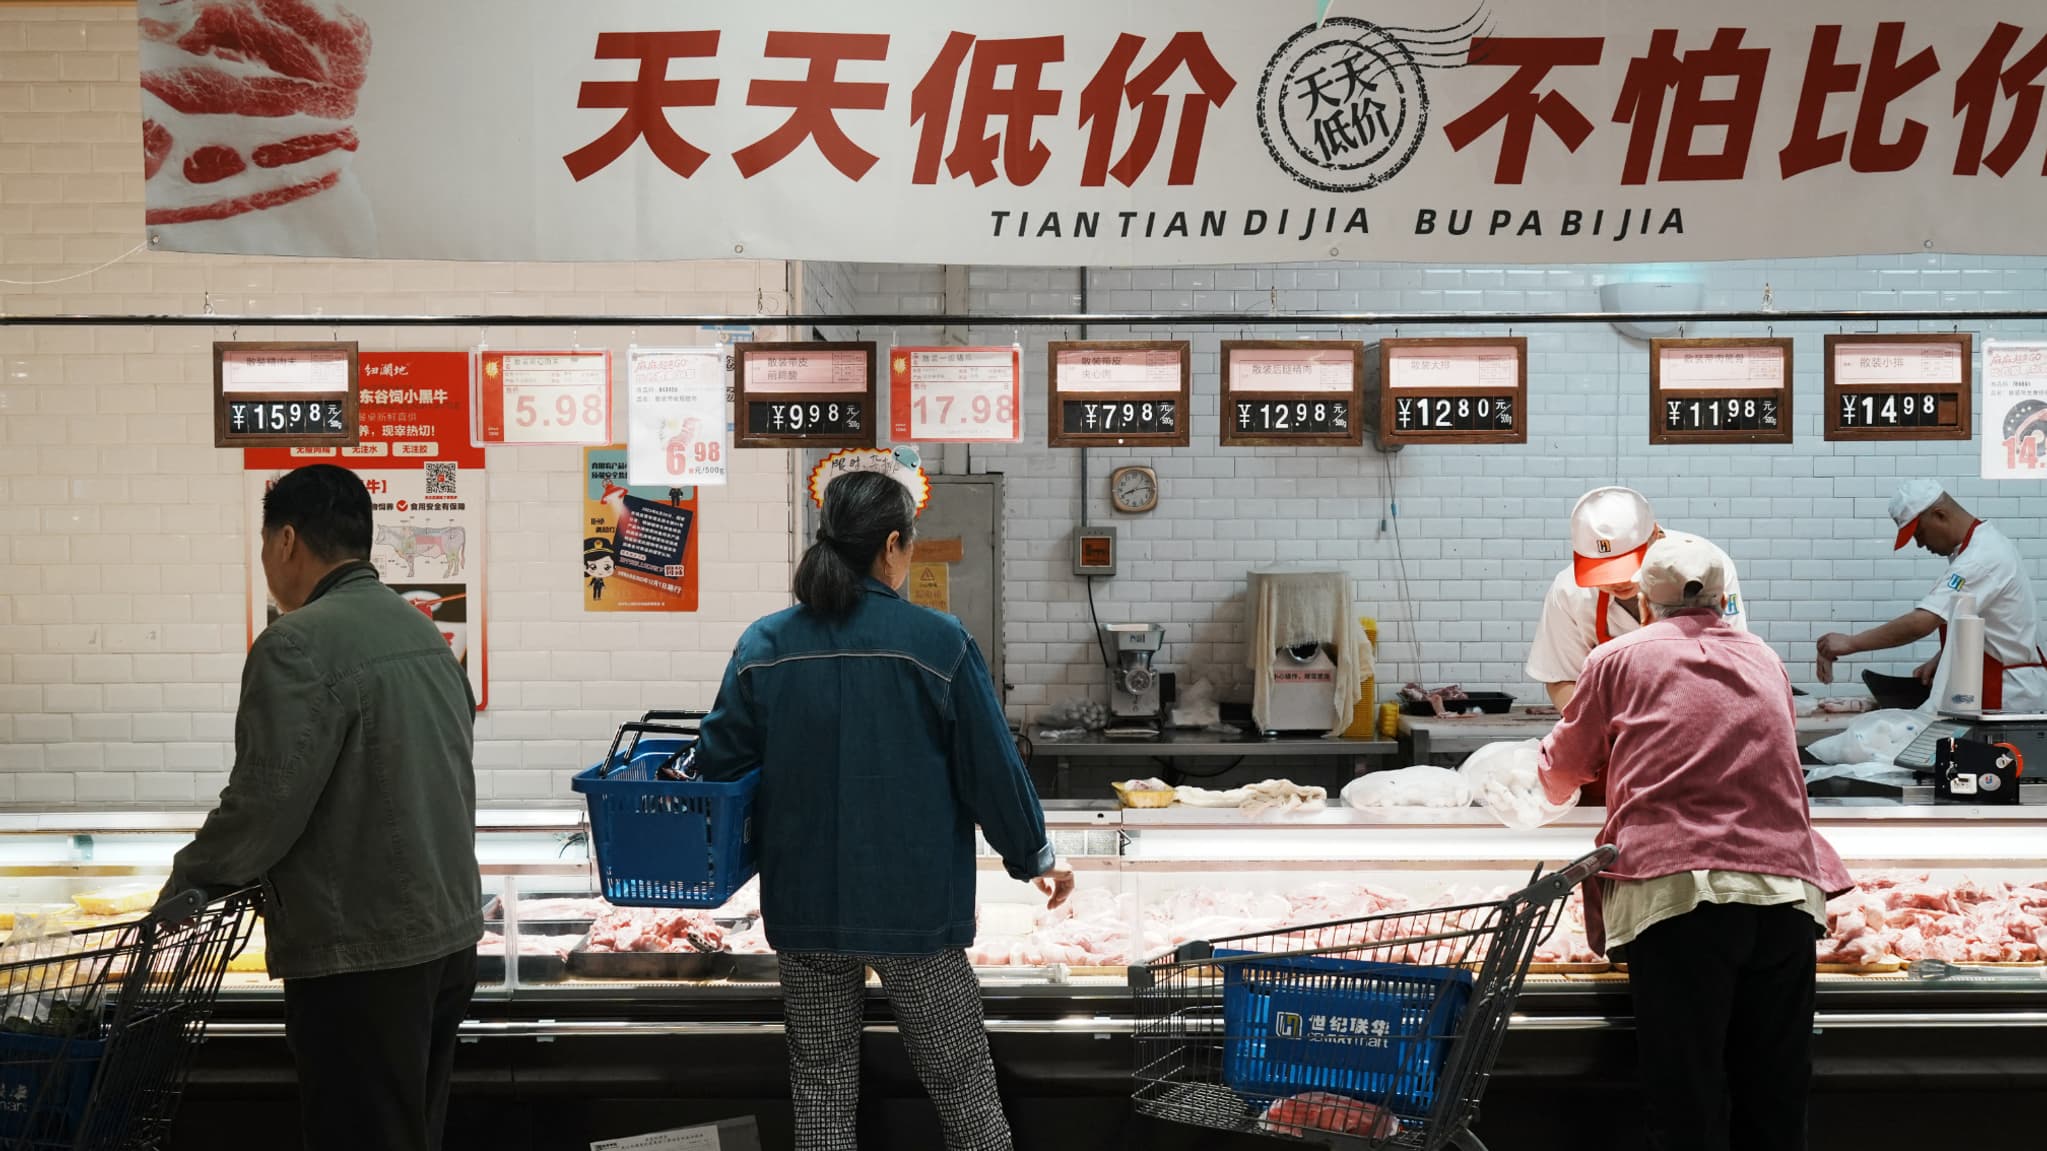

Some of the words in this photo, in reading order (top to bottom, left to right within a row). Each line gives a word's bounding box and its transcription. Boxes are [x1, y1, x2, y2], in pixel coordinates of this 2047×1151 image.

[1294, 51, 1377, 121] 天天
[1443, 21, 2047, 185] 不怕比价
[562, 29, 1237, 187] 天天低价
[1314, 97, 1390, 161] 低价
[359, 388, 449, 405] 东谷饲小黑牛
[515, 394, 604, 428] 5.98
[913, 394, 1013, 425] 17.98
[411, 502, 465, 511] 食用安全有保障
[1308, 1014, 1390, 1036] 世纪联华
